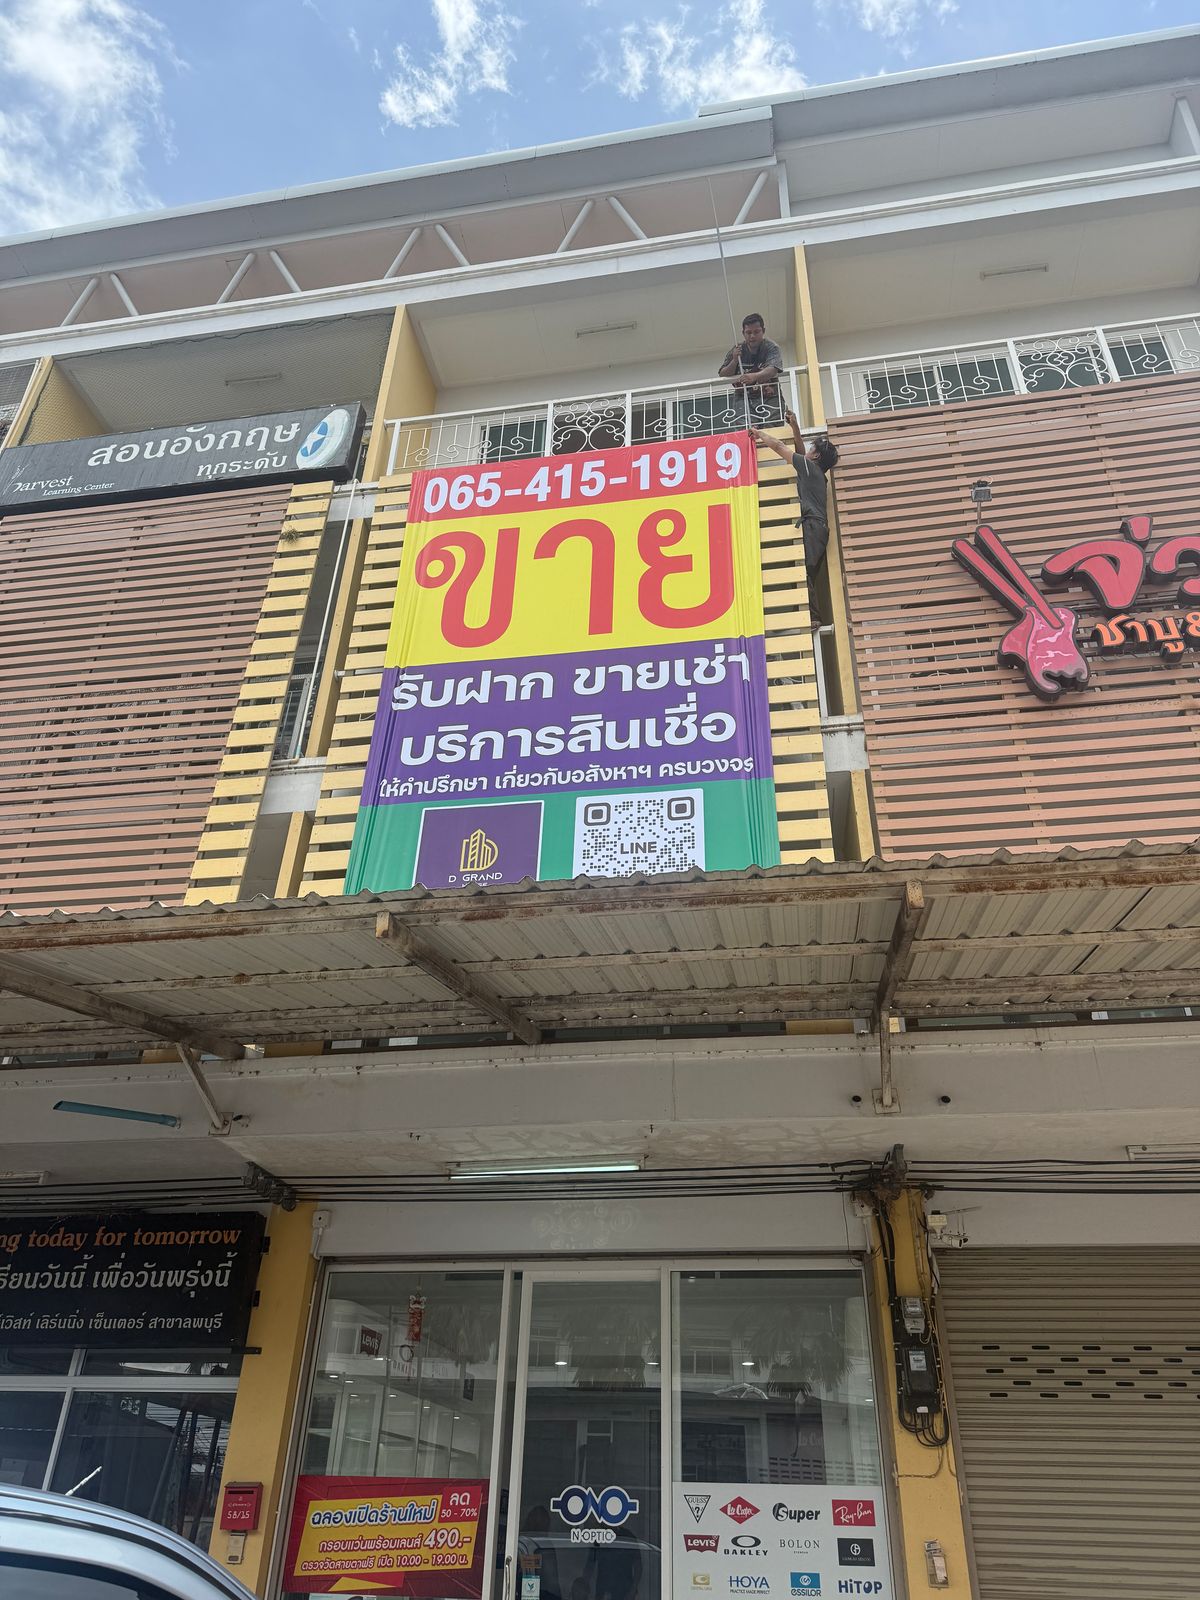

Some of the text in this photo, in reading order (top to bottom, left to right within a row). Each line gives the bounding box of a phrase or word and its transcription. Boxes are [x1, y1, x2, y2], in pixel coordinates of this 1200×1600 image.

[87, 422, 301, 467] สอนอังกฤษ
[196, 452, 287, 480] ทุกระดับ
[423, 442, 742, 514] 065-415-1919
[43, 482, 115, 496] Learning Center
[414, 503, 736, 648] ขาย
[391, 643, 751, 711] รับฝาก ขายเช่า
[399, 692, 737, 767] บริการสินเชื่อ
[379, 774, 488, 798] ให้คำปรึกษา
[494, 765, 652, 790] เกี่ยวกับอสังหาฯ
[619, 841, 658, 856] LINE
[448, 872, 503, 883] D GRAND
[28, 1227, 89, 1251] today
[94, 1226, 128, 1247] for
[133, 1228, 242, 1246] tomorrow
[92, 1252, 238, 1298] เพื่อวันพรุ่งนี้
[0, 1312, 35, 1330] เวิสท์
[88, 1311, 147, 1329] เซ็นเตอร์
[148, 1312, 224, 1334] สาขาลพบุรี
[449, 1491, 471, 1506] ลด
[310, 1498, 438, 1529] ฉลองเปิดร้านใหม่
[440, 1509, 451, 1518] 50
[459, 1507, 478, 1517] 70%
[772, 1502, 821, 1523] Super
[319, 1527, 473, 1553] กรอบแว่นพร้อมเลนส์ 490.-
[723, 1548, 769, 1556] OAKLEY
[779, 1539, 821, 1549] BOLON
[301, 1556, 375, 1572] ตรวจวัดสายตาฟรี
[377, 1555, 394, 1568] เปิด
[396, 1555, 422, 1567] 10.00
[432, 1553, 458, 1566] 19.00
[729, 1575, 770, 1589] HOYA
